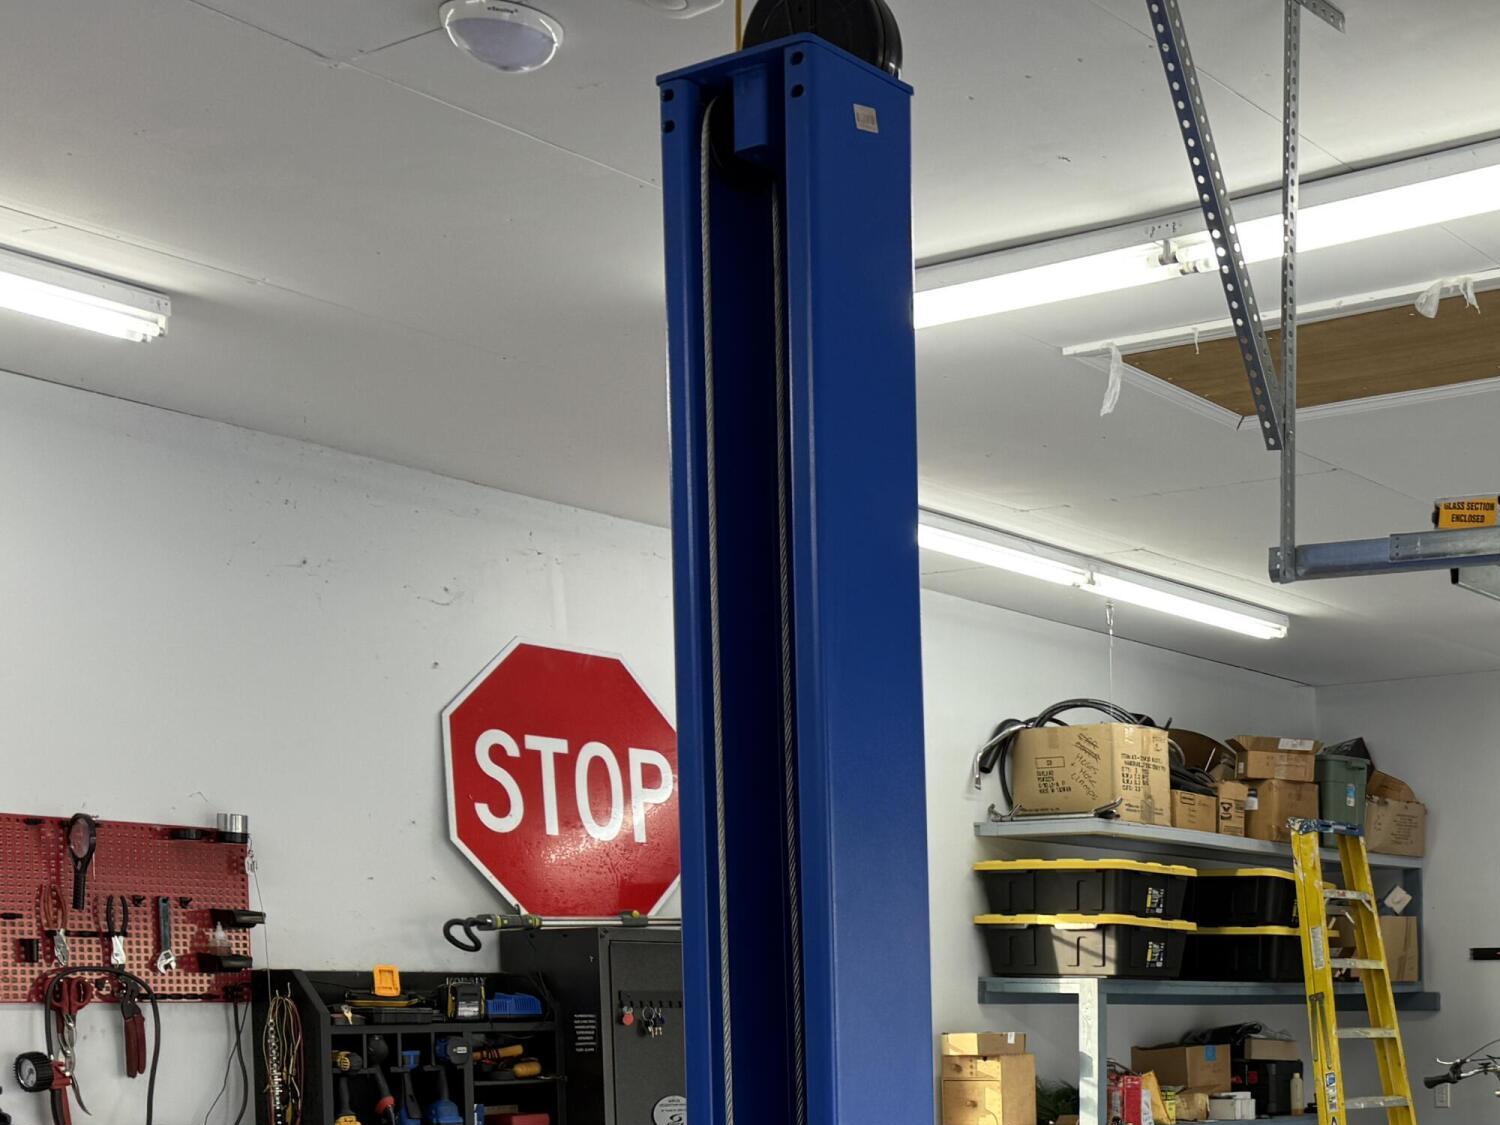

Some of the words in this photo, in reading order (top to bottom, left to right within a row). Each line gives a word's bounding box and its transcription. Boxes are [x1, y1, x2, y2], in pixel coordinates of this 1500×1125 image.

[1465, 501, 1495, 511] SECTION
[1451, 514, 1485, 523] ENCLOSED
[474, 728, 673, 843] STOP
